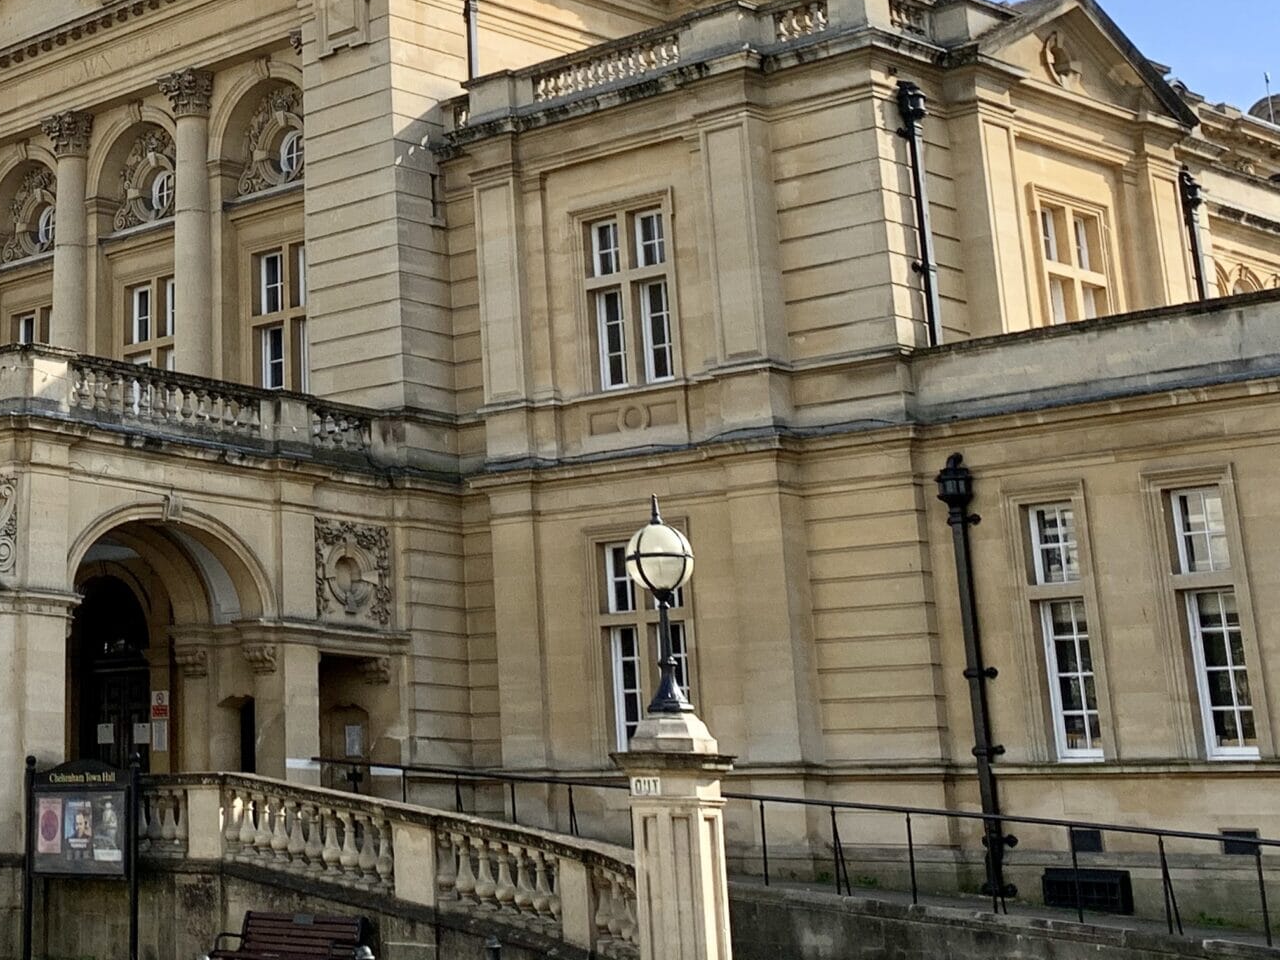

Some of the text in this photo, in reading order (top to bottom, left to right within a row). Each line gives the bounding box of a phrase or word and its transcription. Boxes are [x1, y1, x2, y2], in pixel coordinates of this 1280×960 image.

[61, 28, 181, 85] TOWN HALL
[85, 771, 102, 782] Town
[102, 770, 116, 782] Hall
[634, 778, 659, 794] OUT
